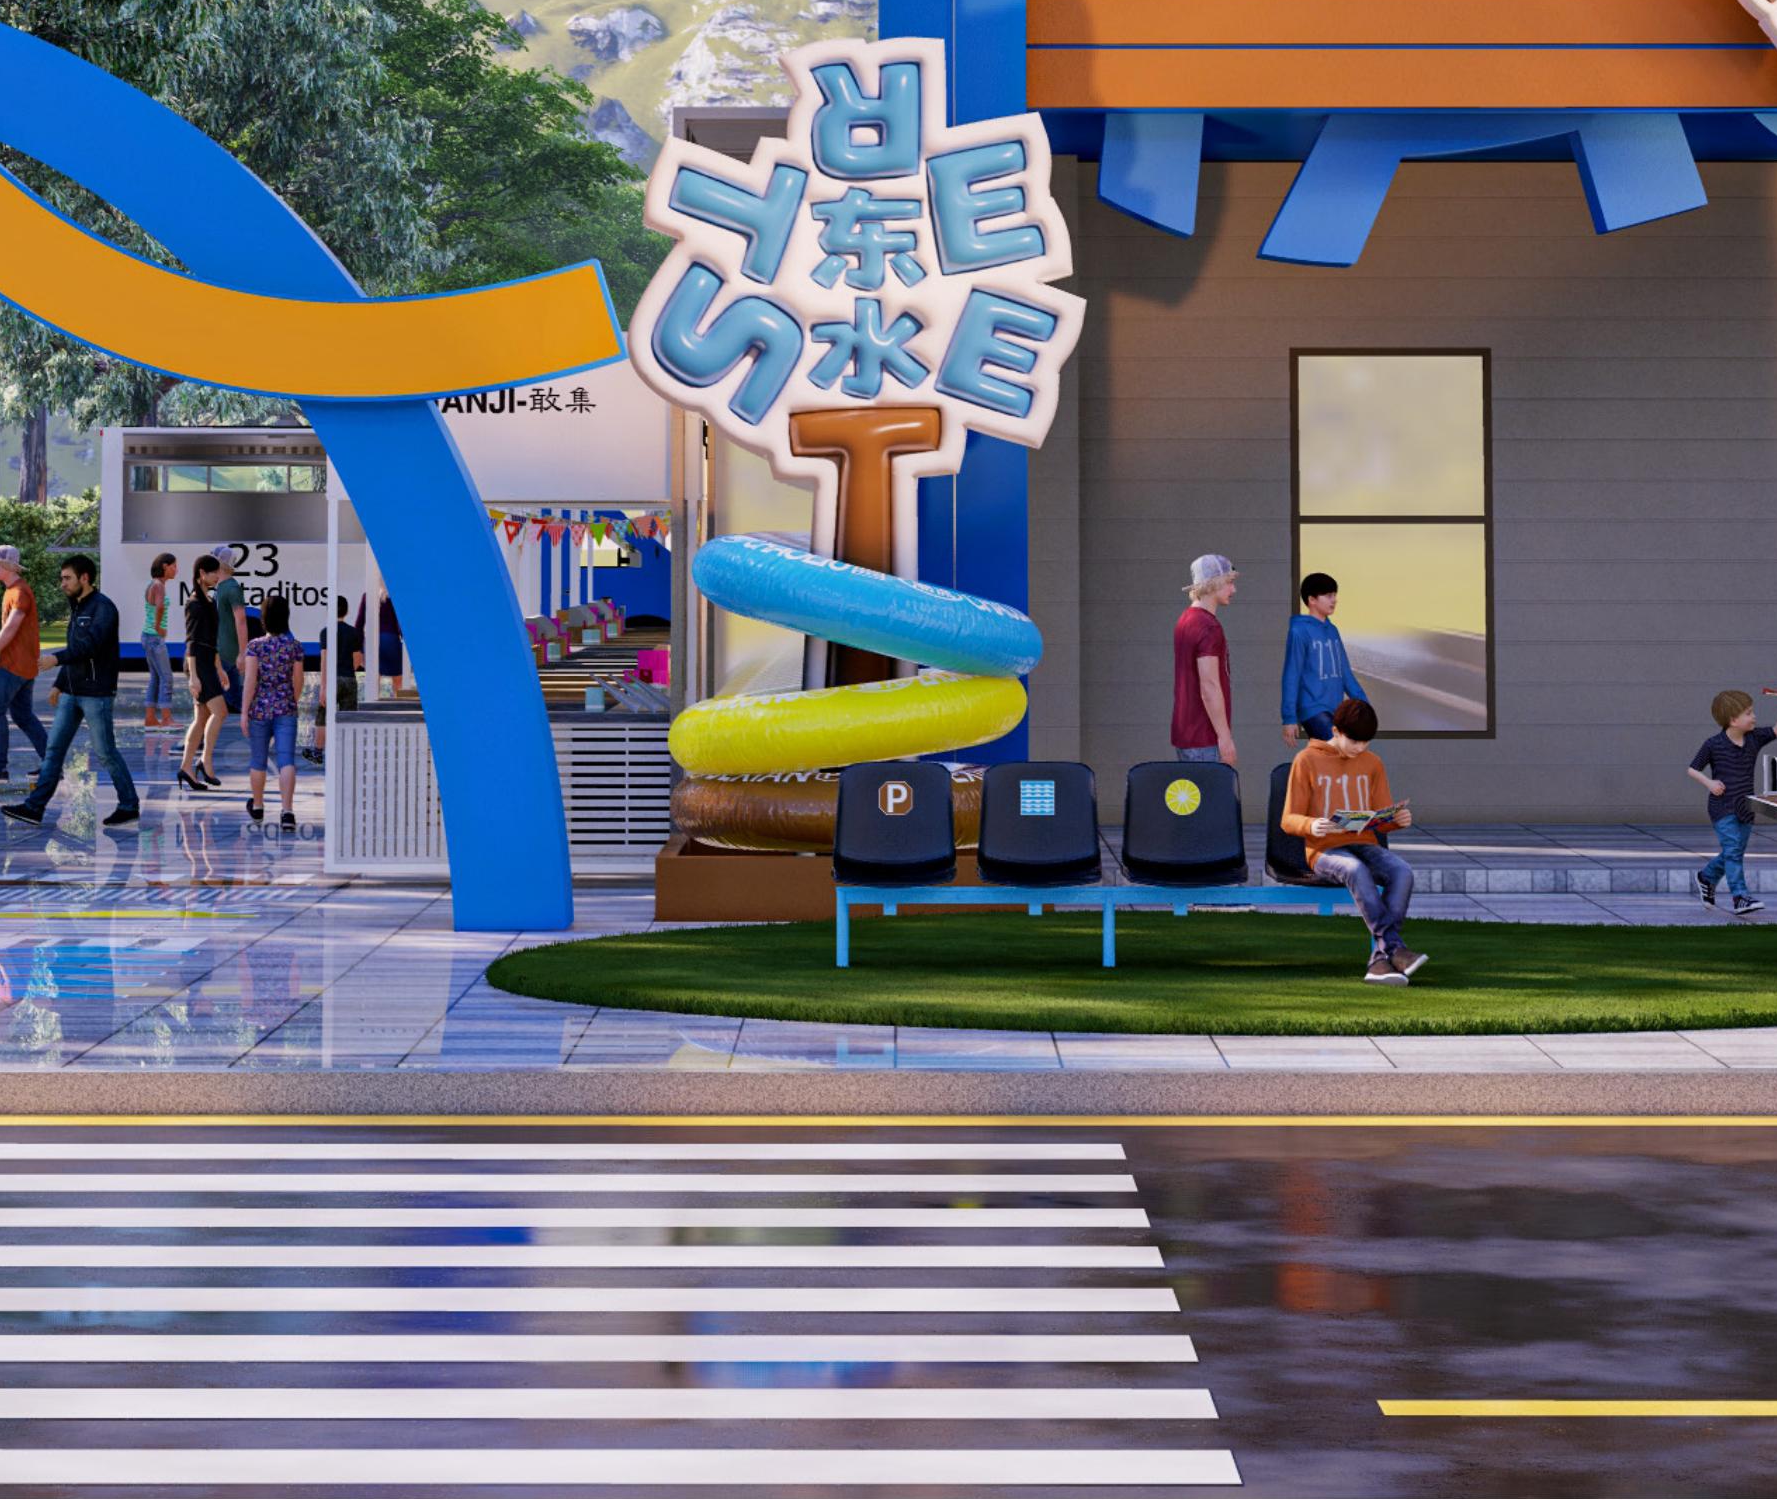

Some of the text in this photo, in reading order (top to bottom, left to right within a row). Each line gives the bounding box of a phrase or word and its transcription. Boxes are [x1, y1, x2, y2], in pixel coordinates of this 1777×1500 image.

[807, 186, 930, 399] 东水
[433, 386, 597, 414] ANJI-敢集
[228, 543, 279, 577] 23
[886, 784, 907, 813] P
